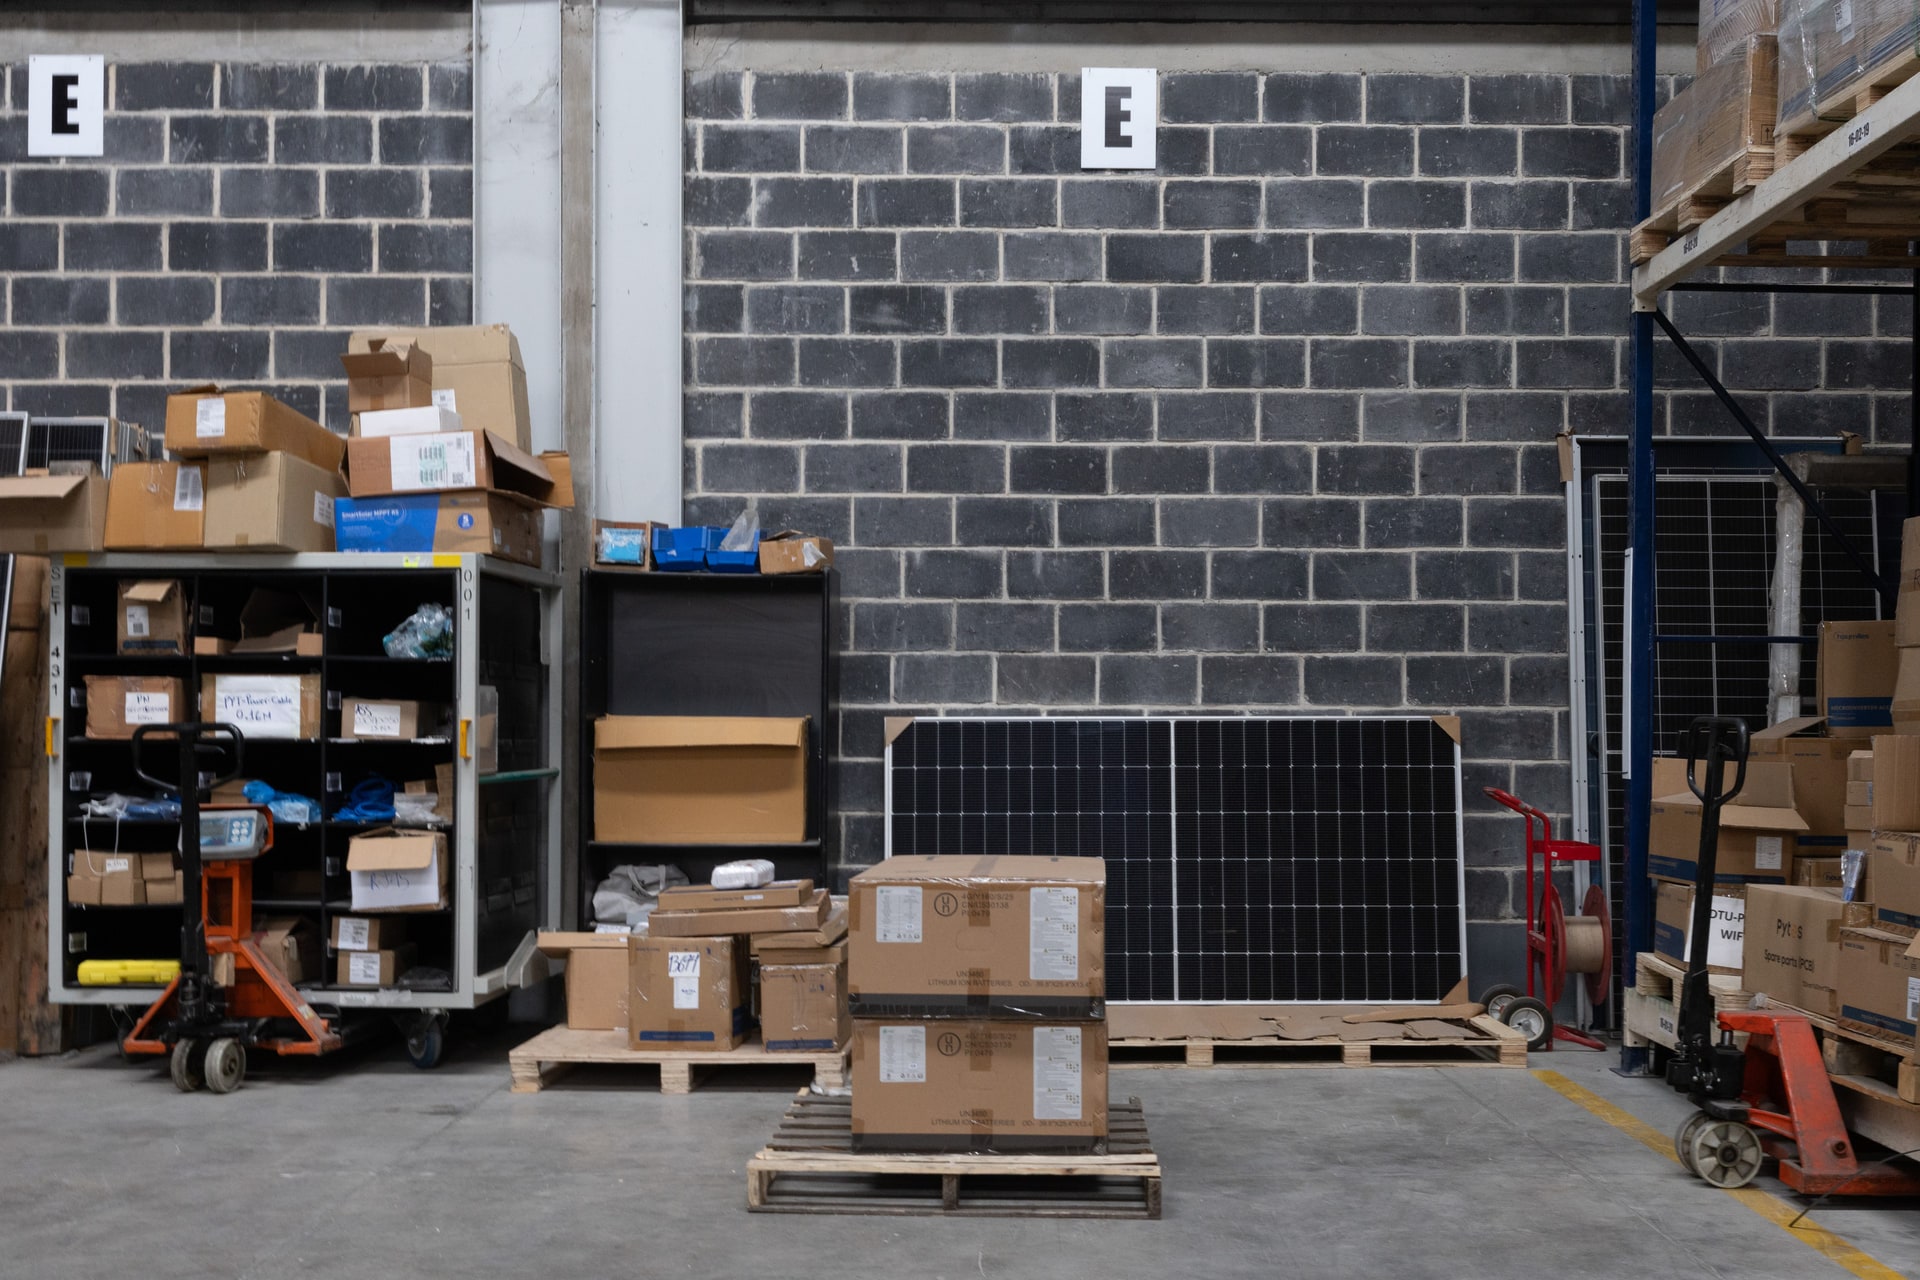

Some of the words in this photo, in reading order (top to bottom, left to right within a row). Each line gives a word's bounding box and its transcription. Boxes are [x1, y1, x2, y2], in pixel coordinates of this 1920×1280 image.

[51, 74, 79, 134] E
[1104, 86, 1132, 147] E
[1709, 908, 1744, 923] DTU-P
[1721, 928, 1744, 941] WIF
[1764, 949, 1780, 964] Spare
[1781, 956, 1798, 969] parts
[927, 979, 957, 987] LITHIUM
